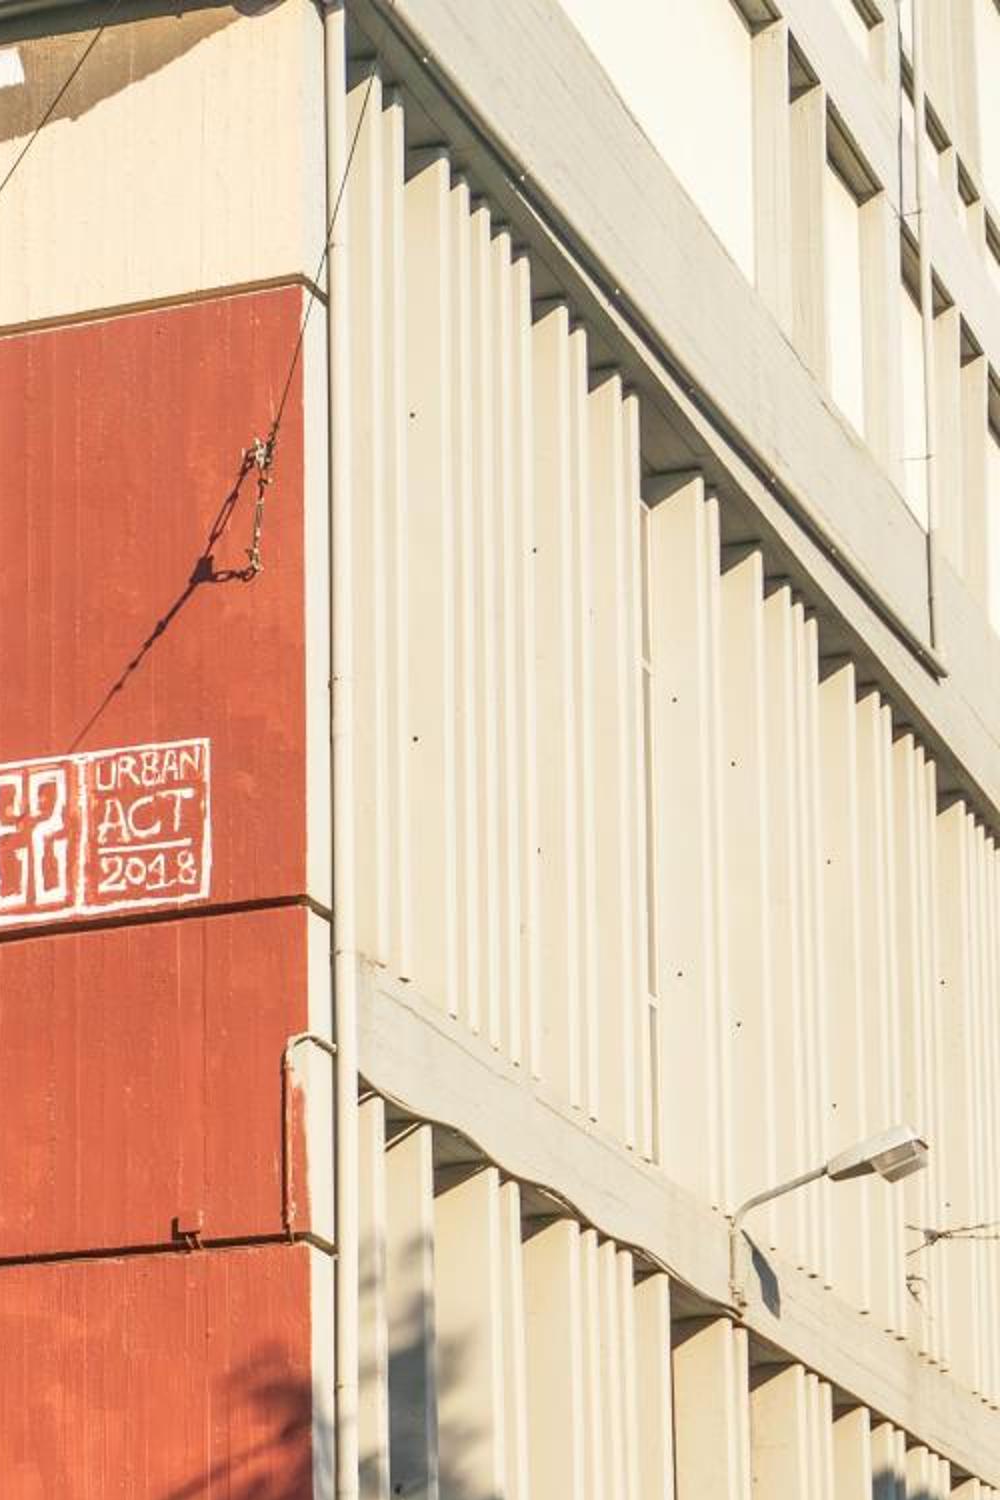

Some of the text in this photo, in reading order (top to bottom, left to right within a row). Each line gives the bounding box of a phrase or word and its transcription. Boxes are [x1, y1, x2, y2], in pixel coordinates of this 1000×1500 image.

[95, 746, 201, 791] URBAN
[97, 788, 195, 843] ACT
[98, 849, 197, 894] 2018
